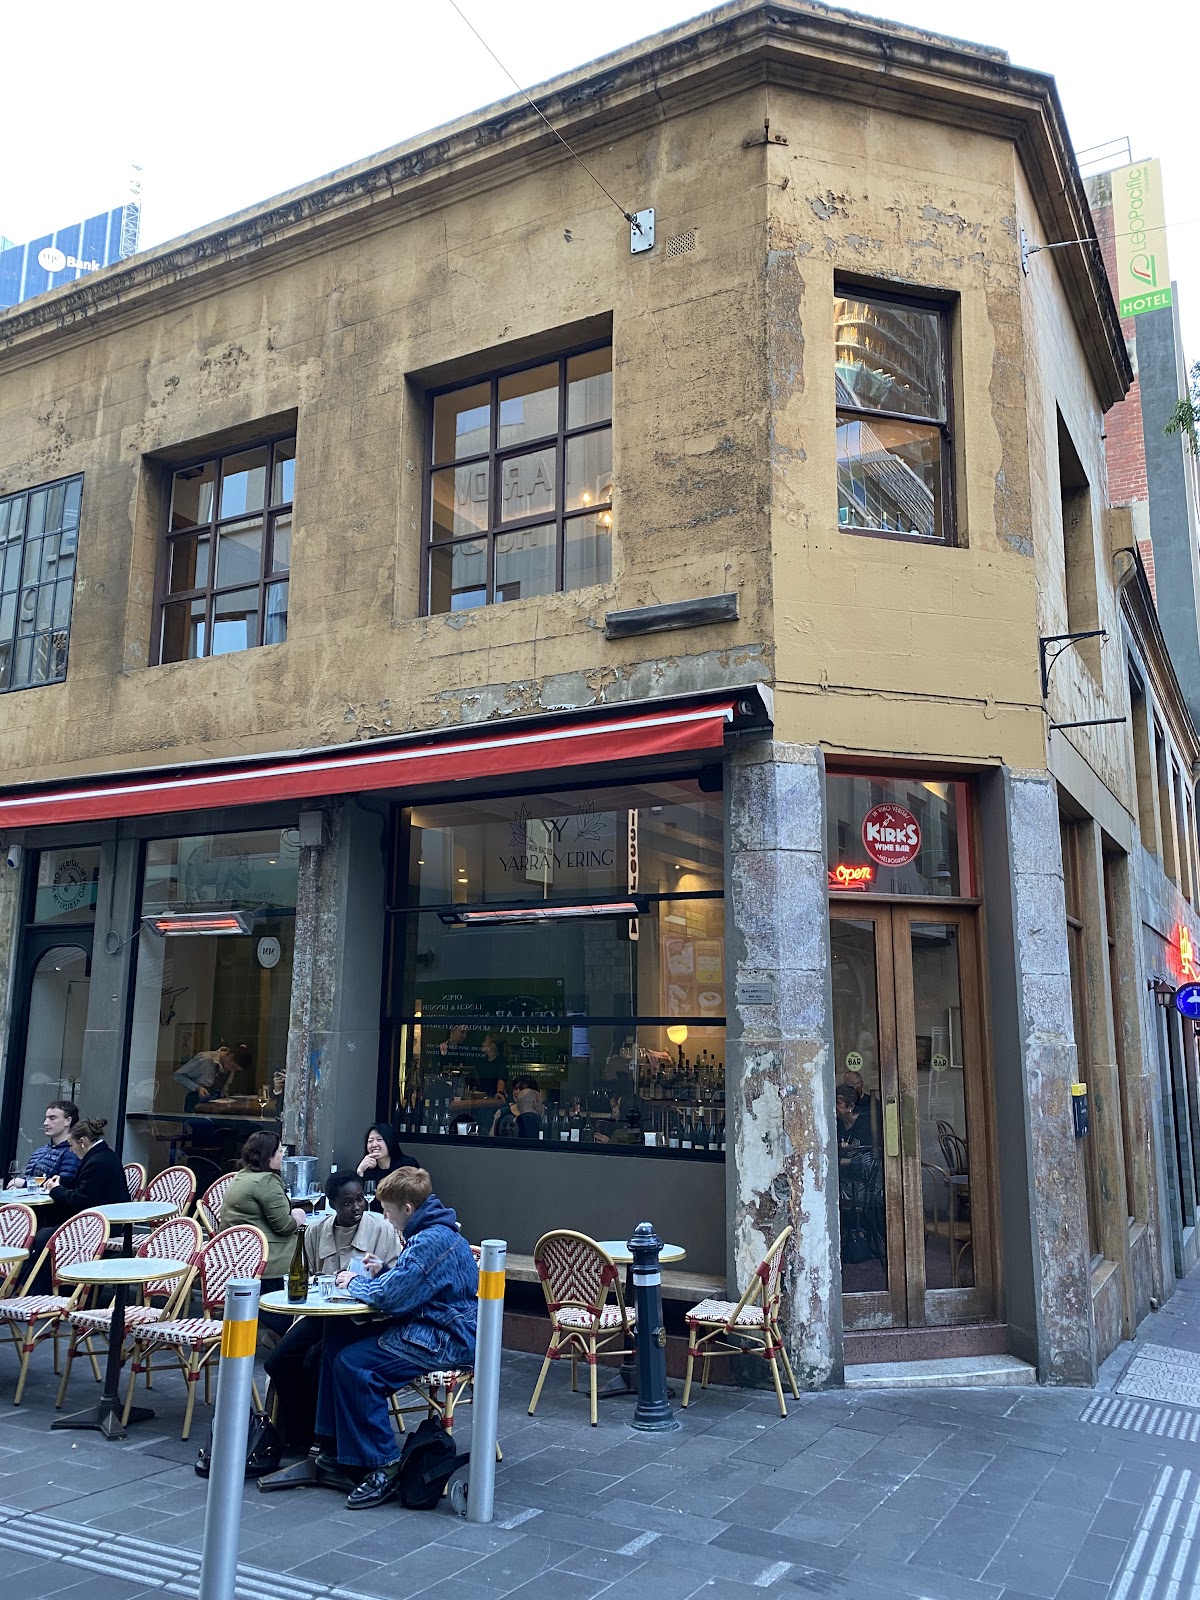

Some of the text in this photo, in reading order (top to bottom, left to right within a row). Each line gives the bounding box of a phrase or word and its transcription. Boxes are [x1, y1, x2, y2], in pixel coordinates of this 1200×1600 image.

[67, 255, 100, 271] Bank
[1122, 293, 1169, 314] HOTEL
[878, 805, 891, 813] VINO
[892, 806, 911, 819] VERITAS
[866, 822, 918, 845] KIRK'S
[875, 842, 910, 852] WINE BAR
[499, 849, 614, 872] YARRA YERING
[879, 855, 907, 864] MELBOURNE
[52, 872, 60, 893] VINO
[59, 860, 80, 871] VERITAS
[836, 865, 871, 886] Open
[79, 877, 87, 898] VINO
